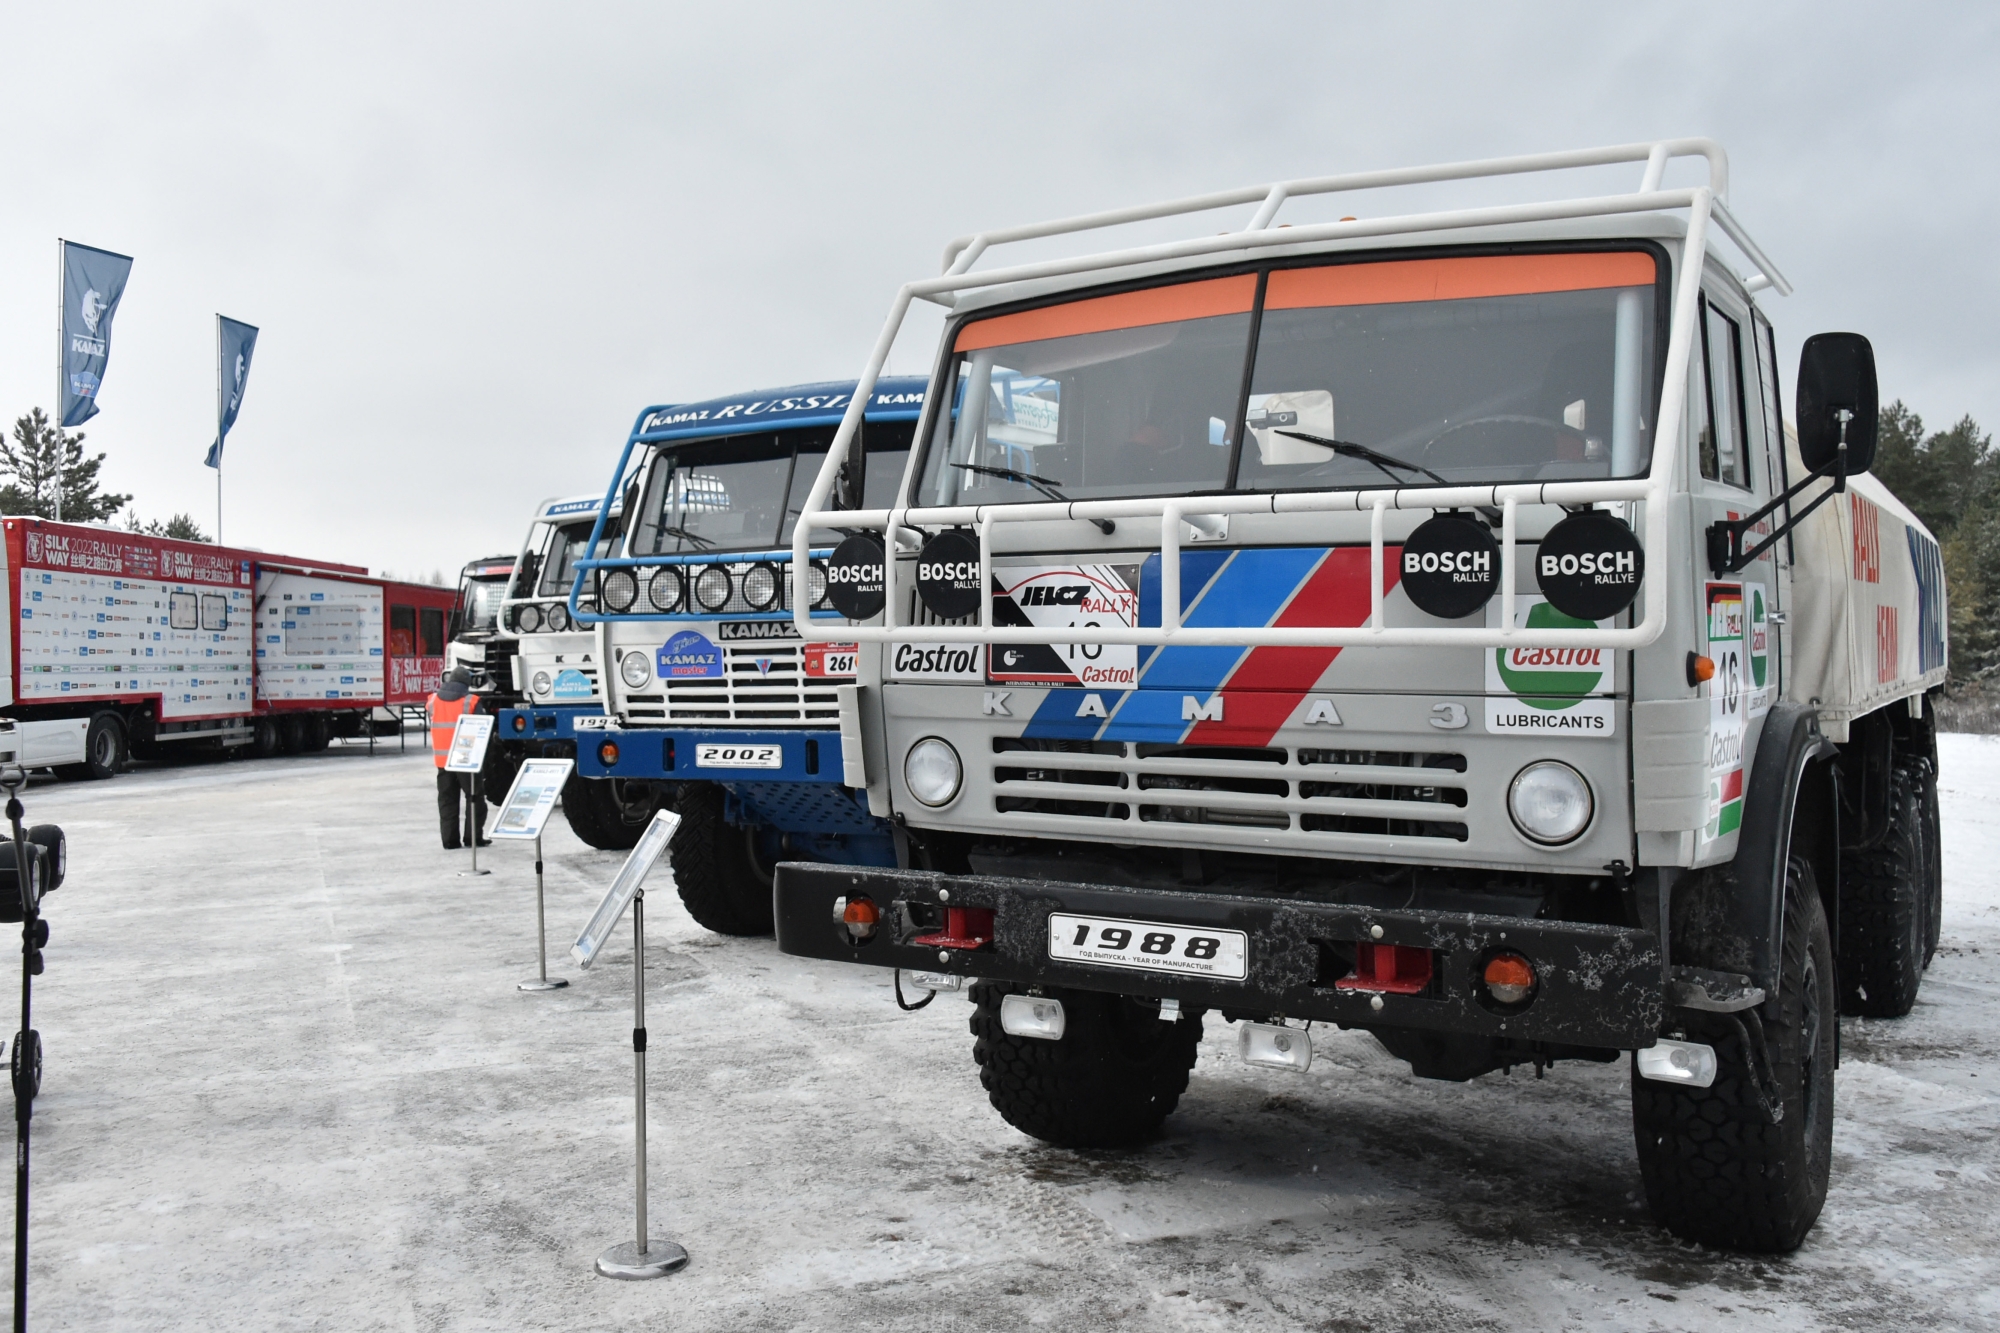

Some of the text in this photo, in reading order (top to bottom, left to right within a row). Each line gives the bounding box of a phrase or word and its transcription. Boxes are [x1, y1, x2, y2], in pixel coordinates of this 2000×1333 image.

[650, 410, 710, 426] KAMAZ
[877, 393, 924, 405] KAM
[554, 502, 590, 513] KAMAZ
[45, 534, 69, 551] SILK
[45, 550, 70, 567] WAY
[174, 551, 193, 566] SILK
[1404, 550, 1490, 573] BOSCH
[1541, 550, 1635, 577] BOSCH
[175, 565, 193, 579] WAY
[828, 563, 883, 584] BOSCH
[919, 561, 981, 581] BOSCH
[1453, 571, 1490, 582] RALLYE
[1594, 573, 1635, 584] RALLYE
[857, 584, 883, 592] RALLYE
[954, 580, 981, 589] RALLYE
[1020, 585, 1131, 613] JELCZ RALLY
[721, 622, 799, 639] KAMAZ
[661, 654, 716, 665] KAMAZ
[829, 655, 853, 672] 261
[894, 642, 979, 674] Castrol
[1512, 646, 1601, 666] Castrol
[404, 658, 422, 675] SILK
[672, 665, 707, 675] master
[1081, 665, 1135, 683] Castrol
[404, 675, 422, 693] WAY
[1719, 651, 1739, 715] 16
[580, 718, 619, 726] 1994
[1496, 714, 1605, 729] LUBRICANTS
[703, 748, 774, 760] 2002
[1711, 727, 1741, 769] Castrol
[1072, 924, 1221, 960] 1988
[1078, 950, 1093, 959] ГОД
[1093, 952, 1126, 961] ВЫПУСКА
[1132, 956, 1150, 964] YEAR
[1162, 959, 1213, 971] MANUFACTURE
